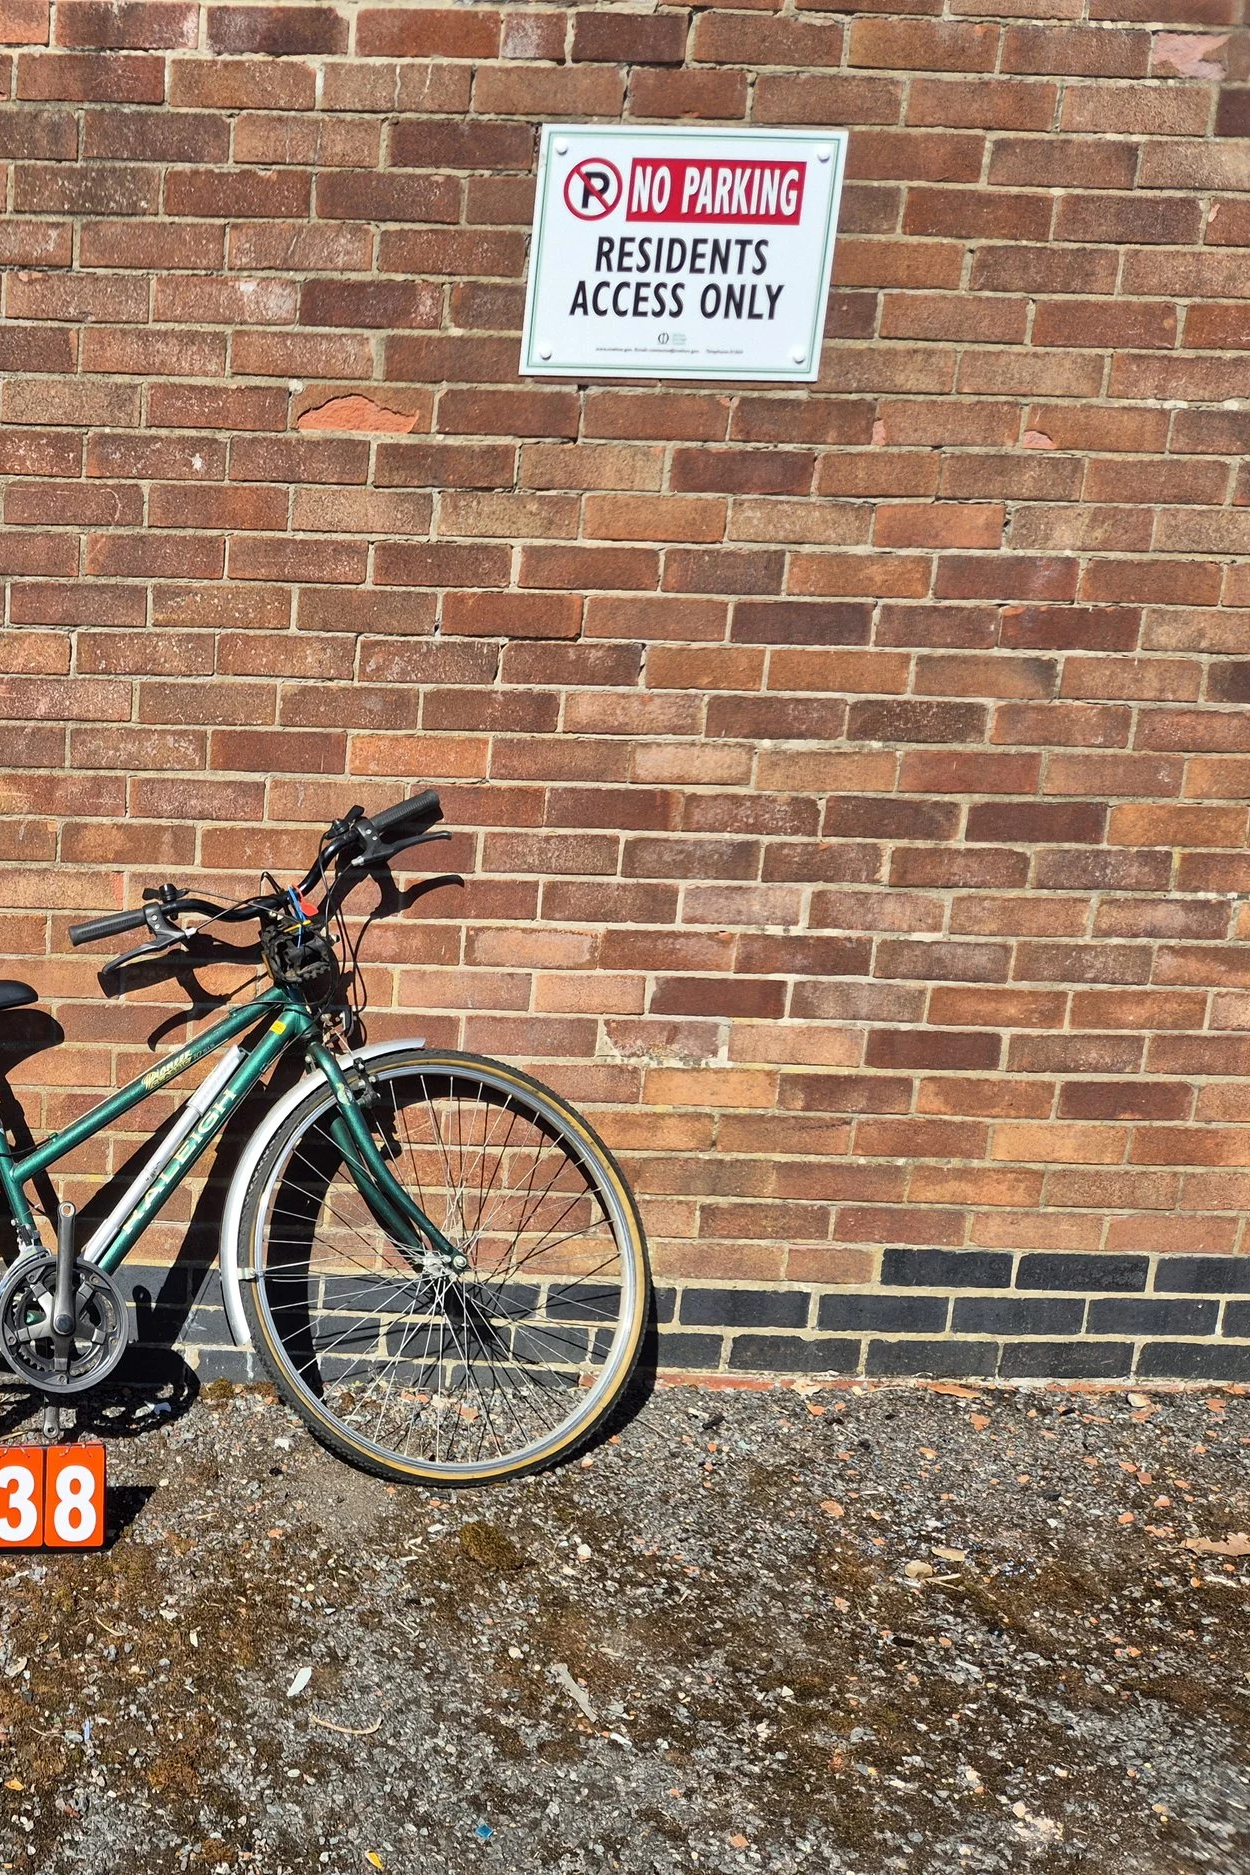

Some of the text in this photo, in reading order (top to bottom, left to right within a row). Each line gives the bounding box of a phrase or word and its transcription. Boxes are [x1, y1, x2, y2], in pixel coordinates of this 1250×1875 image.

[630, 166, 800, 216] NO PARKING
[595, 236, 769, 276] RESIDENTS
[569, 280, 785, 320] ACCESS ONLY
